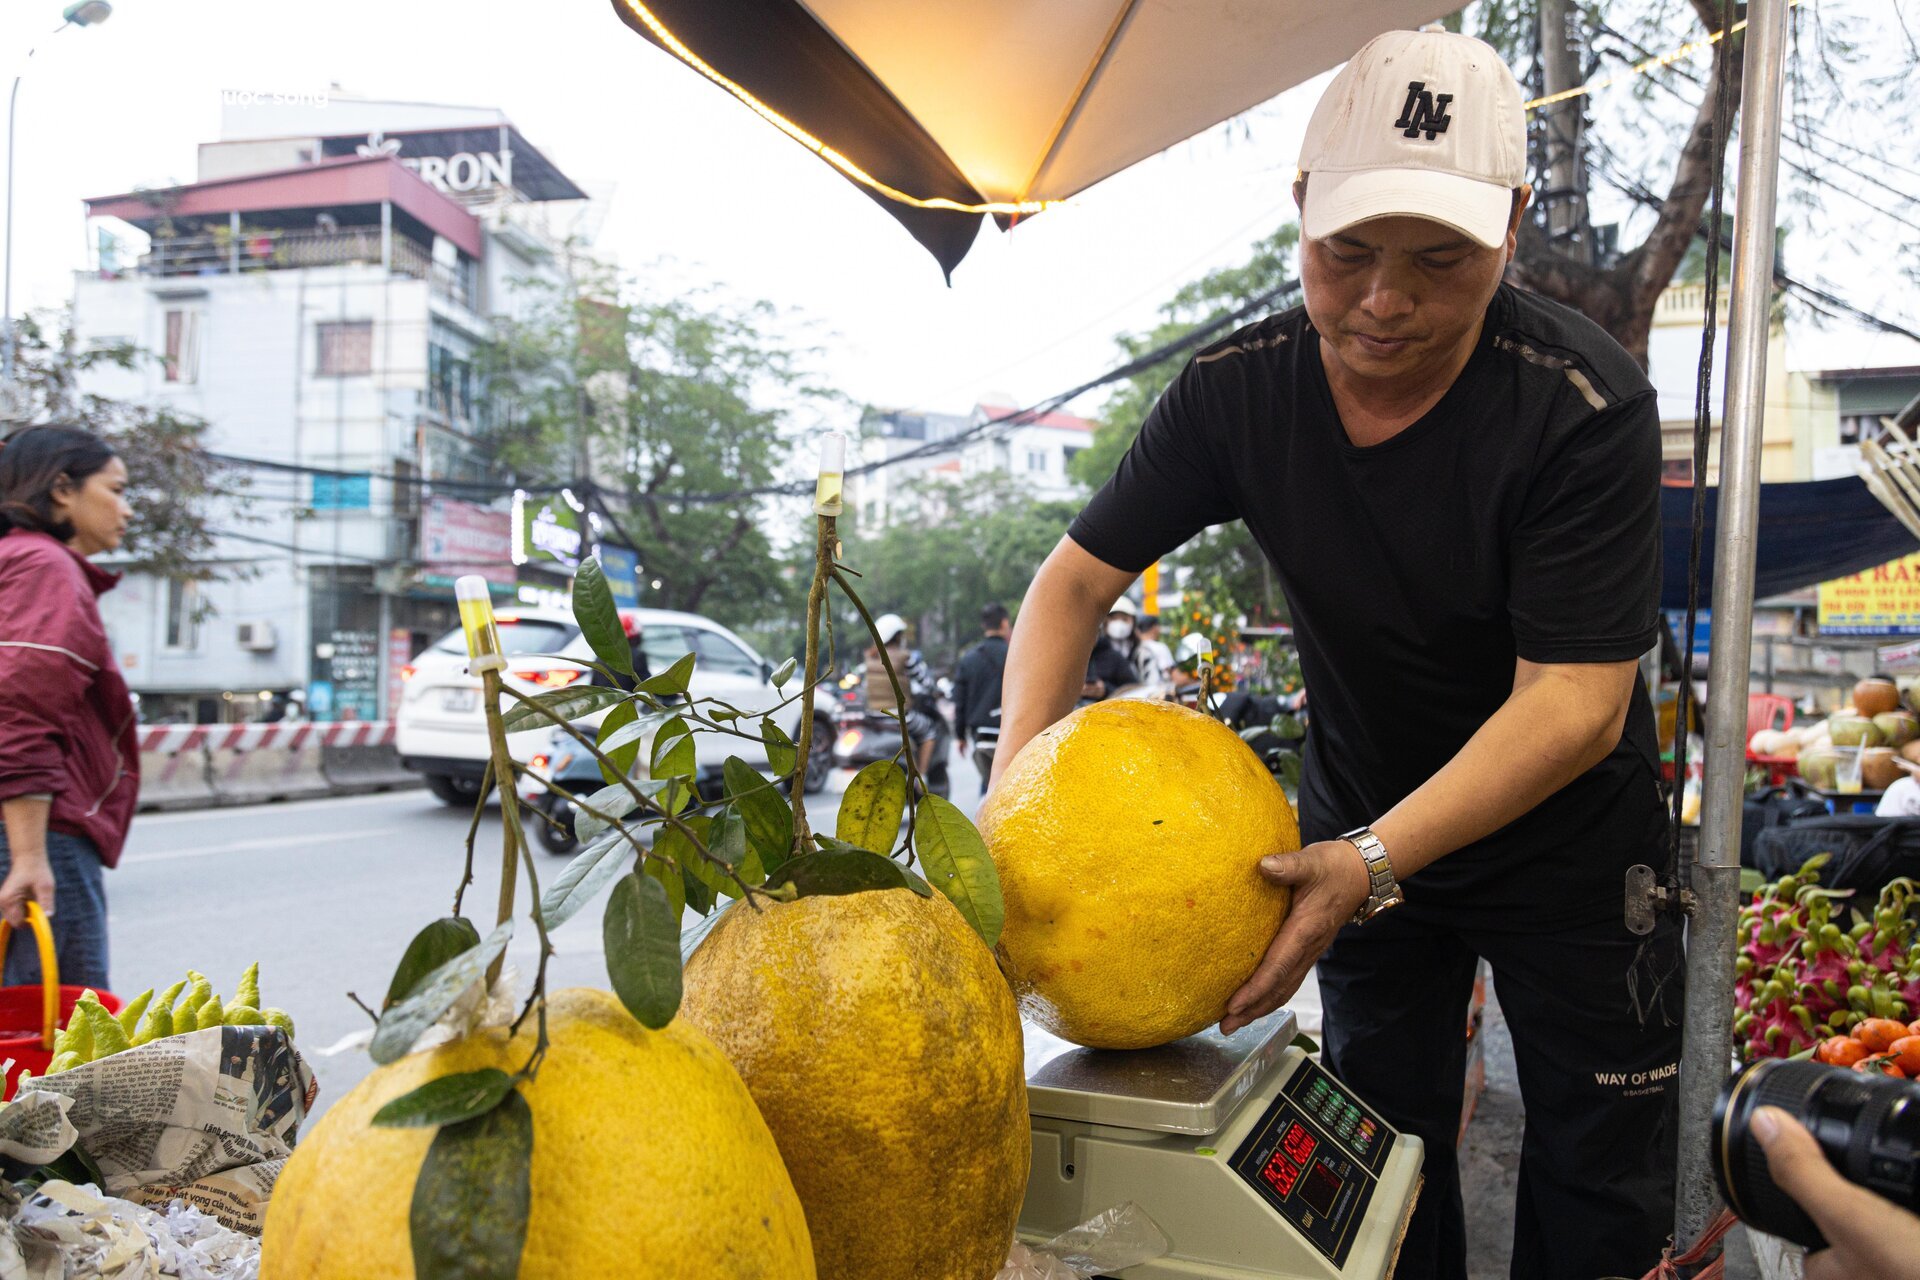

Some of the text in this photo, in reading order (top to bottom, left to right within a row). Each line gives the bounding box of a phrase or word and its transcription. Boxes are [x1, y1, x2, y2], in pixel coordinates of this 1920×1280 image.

[1595, 1063, 1677, 1085] WAY OF WADE
[190, 1193, 211, 1208] vọng
[212, 1197, 225, 1212] của
